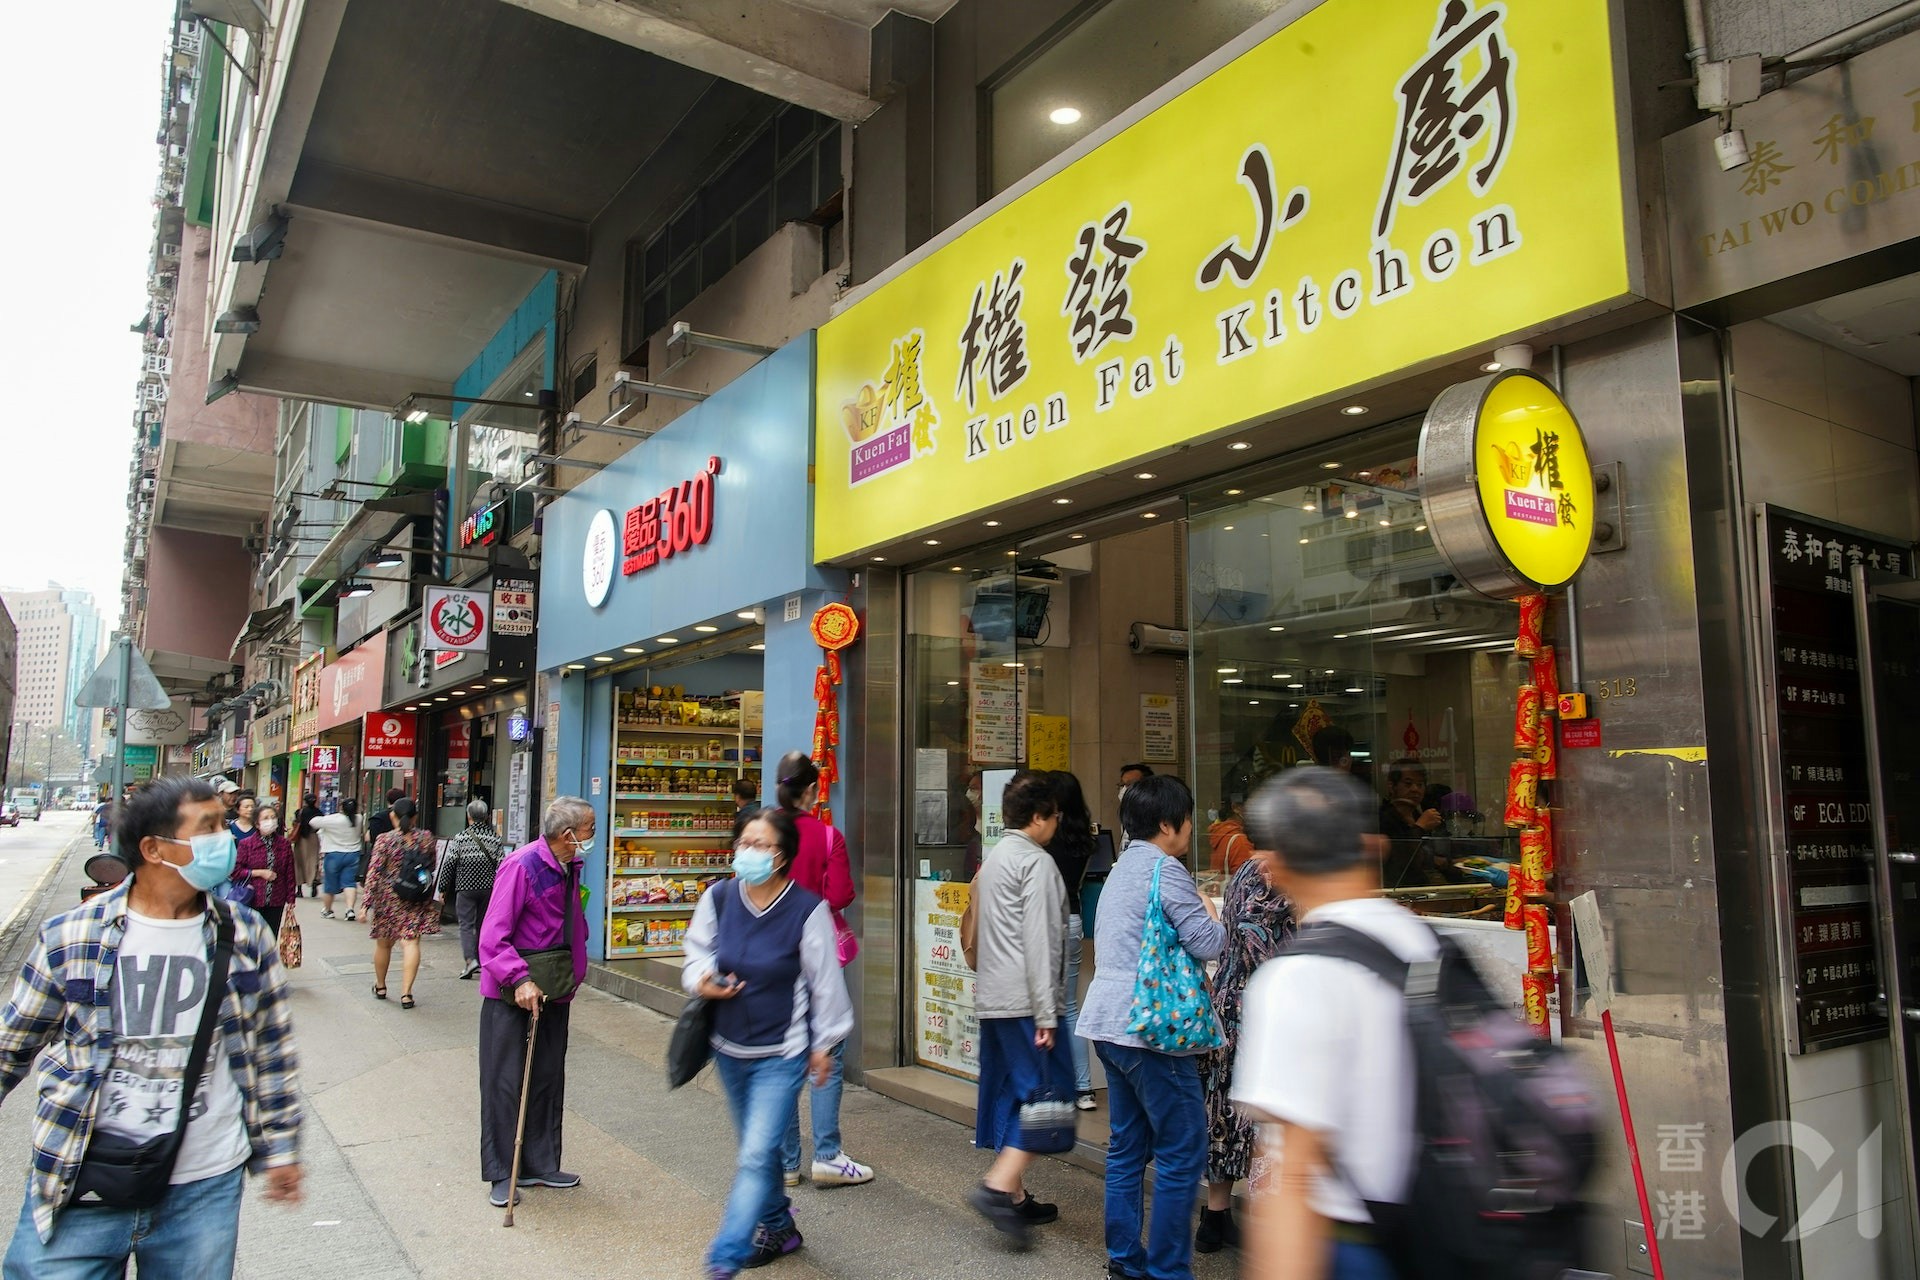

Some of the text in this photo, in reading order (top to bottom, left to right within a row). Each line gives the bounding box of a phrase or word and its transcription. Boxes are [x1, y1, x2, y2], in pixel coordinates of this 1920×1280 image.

[1700, 222, 1753, 258] TAI
[1760, 201, 1814, 236] WO
[967, 212, 1515, 458] Kuen Fat Kitchen
[860, 406, 878, 431] KF
[855, 428, 909, 466] Kuen Fat
[1510, 463, 1526, 480] KF
[1508, 491, 1555, 513] Kuen Fat
[1513, 511, 1552, 523] RESTAURANT
[446, 593, 470, 604] ICE
[440, 604, 475, 635] 冰
[1600, 677, 1637, 699] 513
[1818, 803, 1846, 824] ECA
[931, 945, 949, 960] $40
[928, 1015, 944, 1027] $12
[928, 1044, 943, 1057] $10
[961, 1040, 972, 1053] $5
